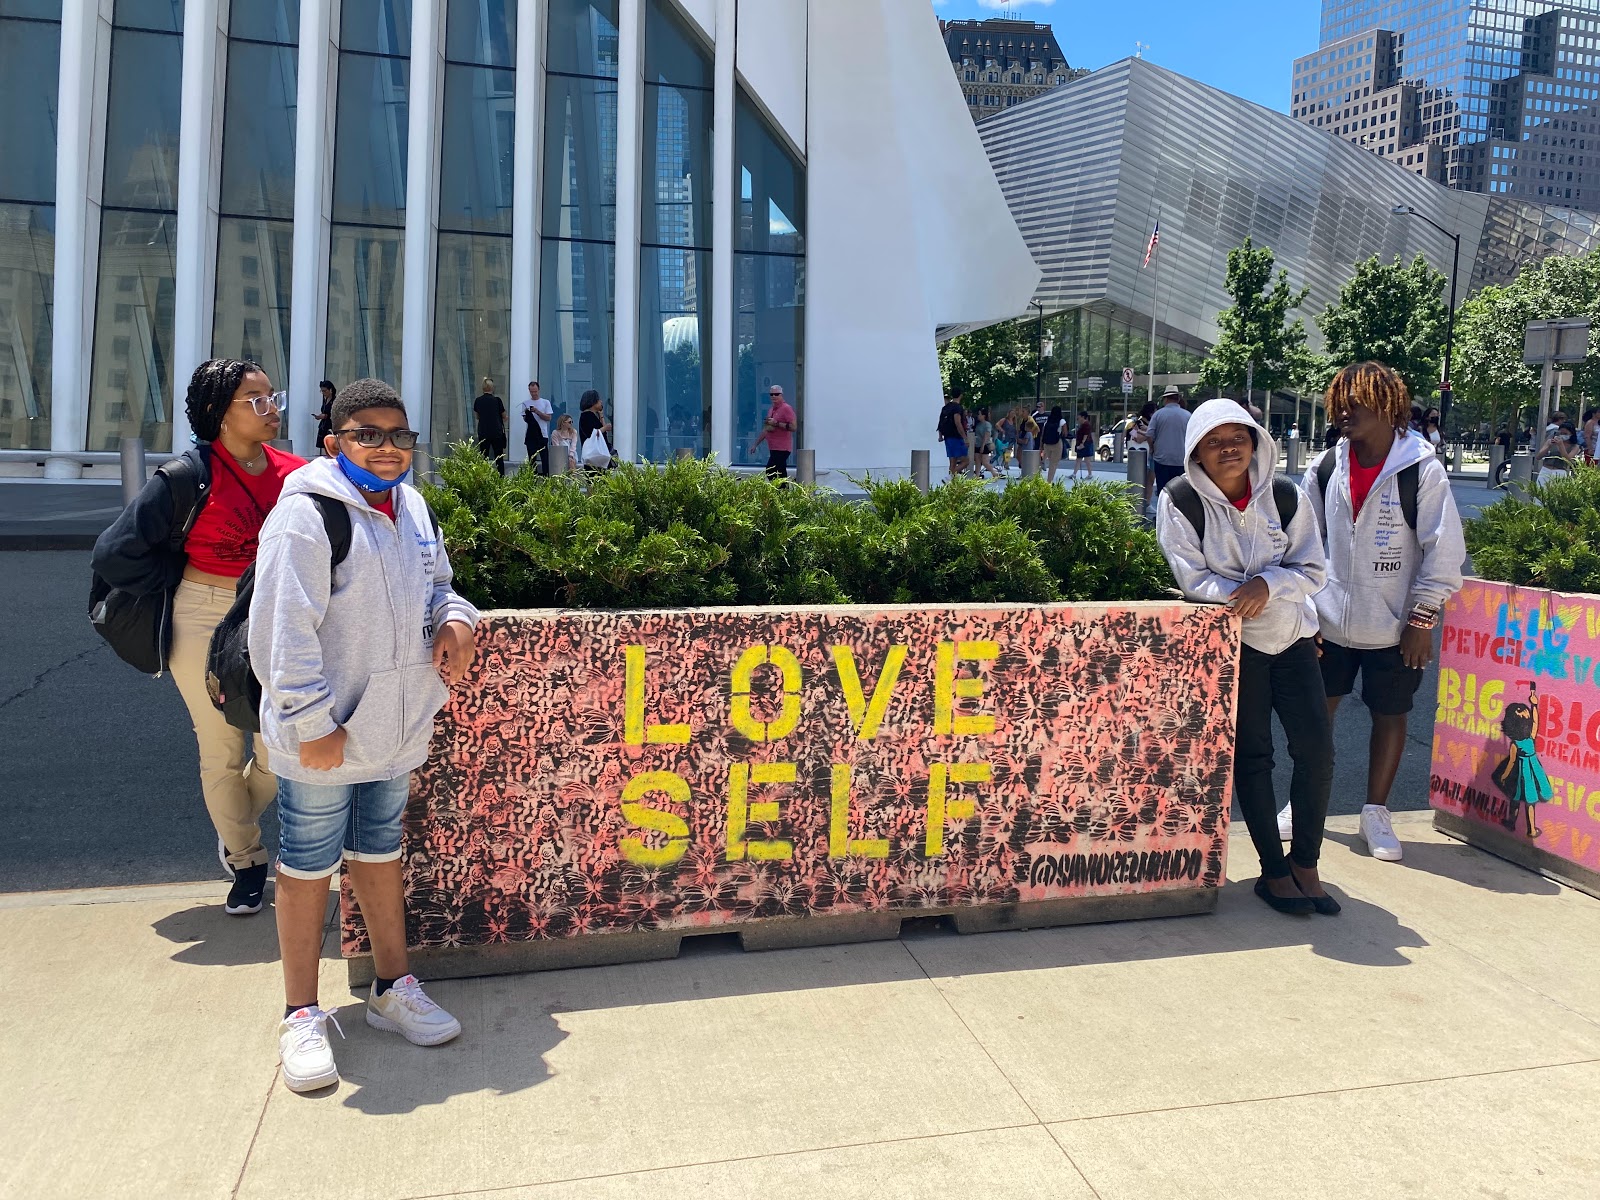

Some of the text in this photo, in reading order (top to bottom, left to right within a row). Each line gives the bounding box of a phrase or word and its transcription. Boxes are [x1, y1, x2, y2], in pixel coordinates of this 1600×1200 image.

[1372, 561, 1402, 572] TRIO
[625, 641, 999, 745] LOVE
[1435, 706, 1502, 741] DREAMS
[620, 762, 991, 868] SELF
